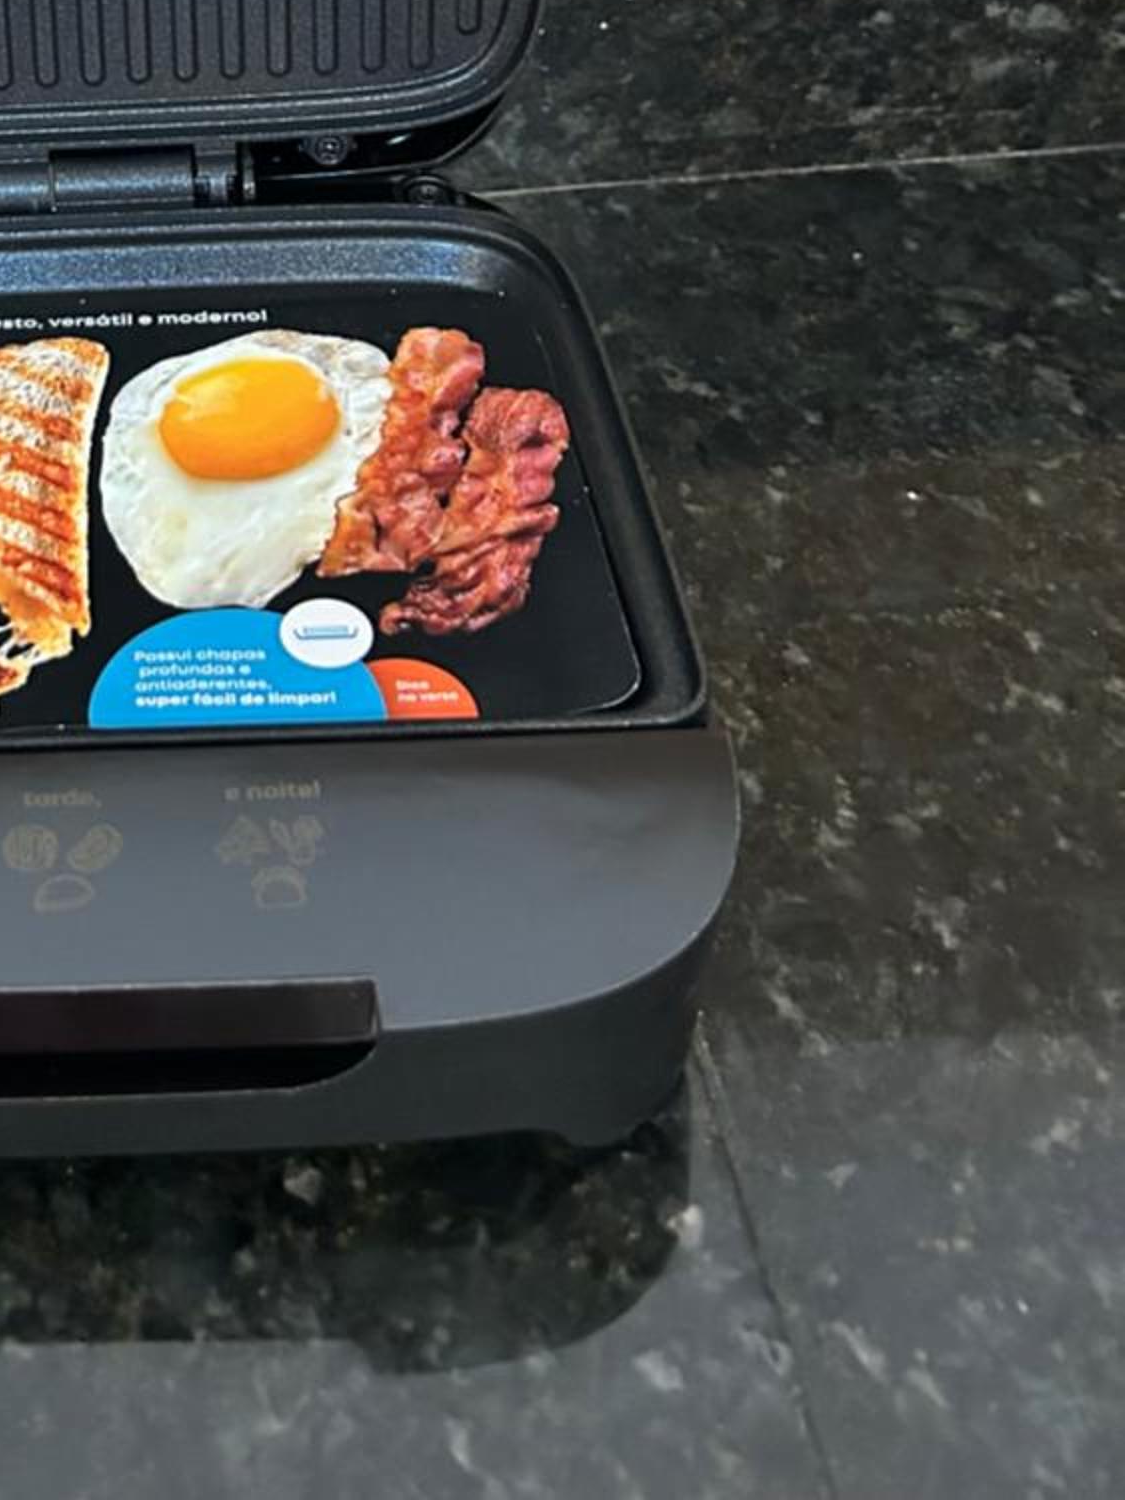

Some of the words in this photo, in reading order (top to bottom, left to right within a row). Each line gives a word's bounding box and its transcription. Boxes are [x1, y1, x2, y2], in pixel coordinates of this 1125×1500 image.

[48, 312, 133, 328] versátil
[138, 314, 153, 326] e
[157, 309, 268, 325] moderno!
[134, 650, 192, 663] Possui
[195, 649, 266, 664] chapas
[139, 664, 235, 678] profundas
[238, 665, 251, 675] e
[135, 694, 189, 708] super
[192, 692, 236, 706] fácil
[239, 693, 266, 705] de
[268, 690, 337, 706] limpar!
